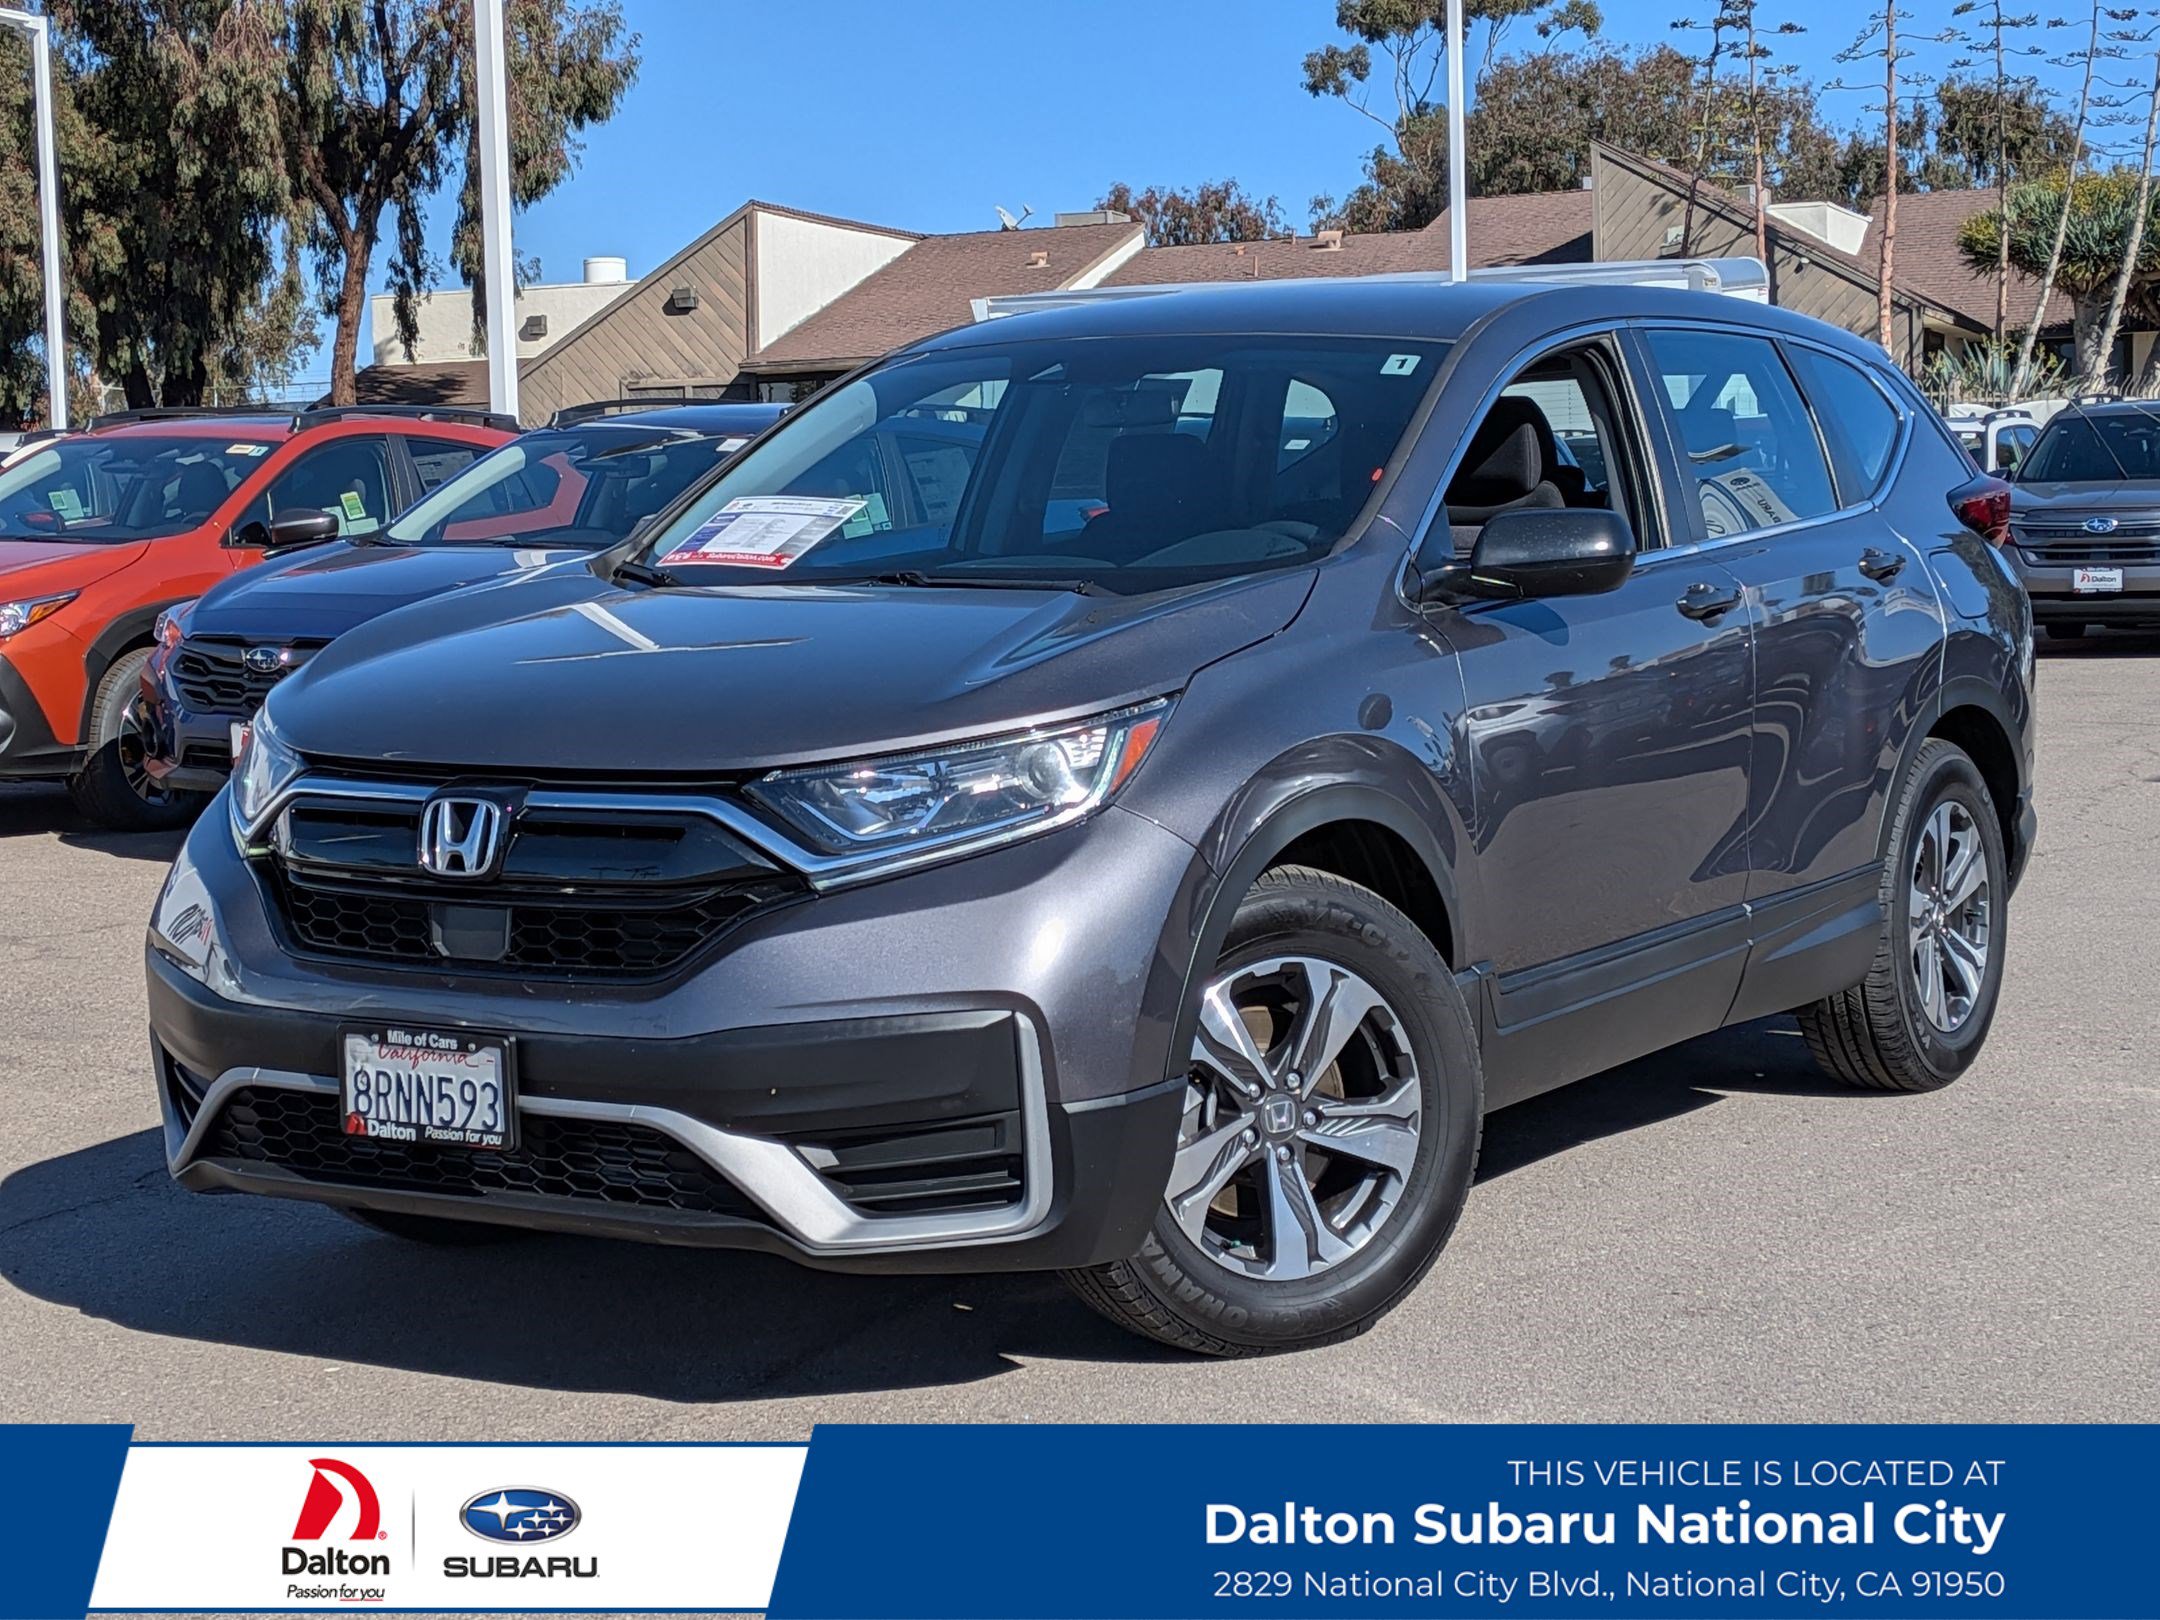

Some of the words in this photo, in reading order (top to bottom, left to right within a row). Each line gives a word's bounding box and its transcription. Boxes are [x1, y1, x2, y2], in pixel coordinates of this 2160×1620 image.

[387, 1029, 412, 1046] Mile
[413, 1032, 428, 1047] of
[429, 1034, 458, 1050] Cars
[378, 1043, 479, 1069] California
[353, 1069, 500, 1131] 8RNN593
[367, 1119, 417, 1141] Dalton
[425, 1125, 464, 1143] Passion
[465, 1129, 481, 1144] for
[482, 1132, 502, 1147] you
